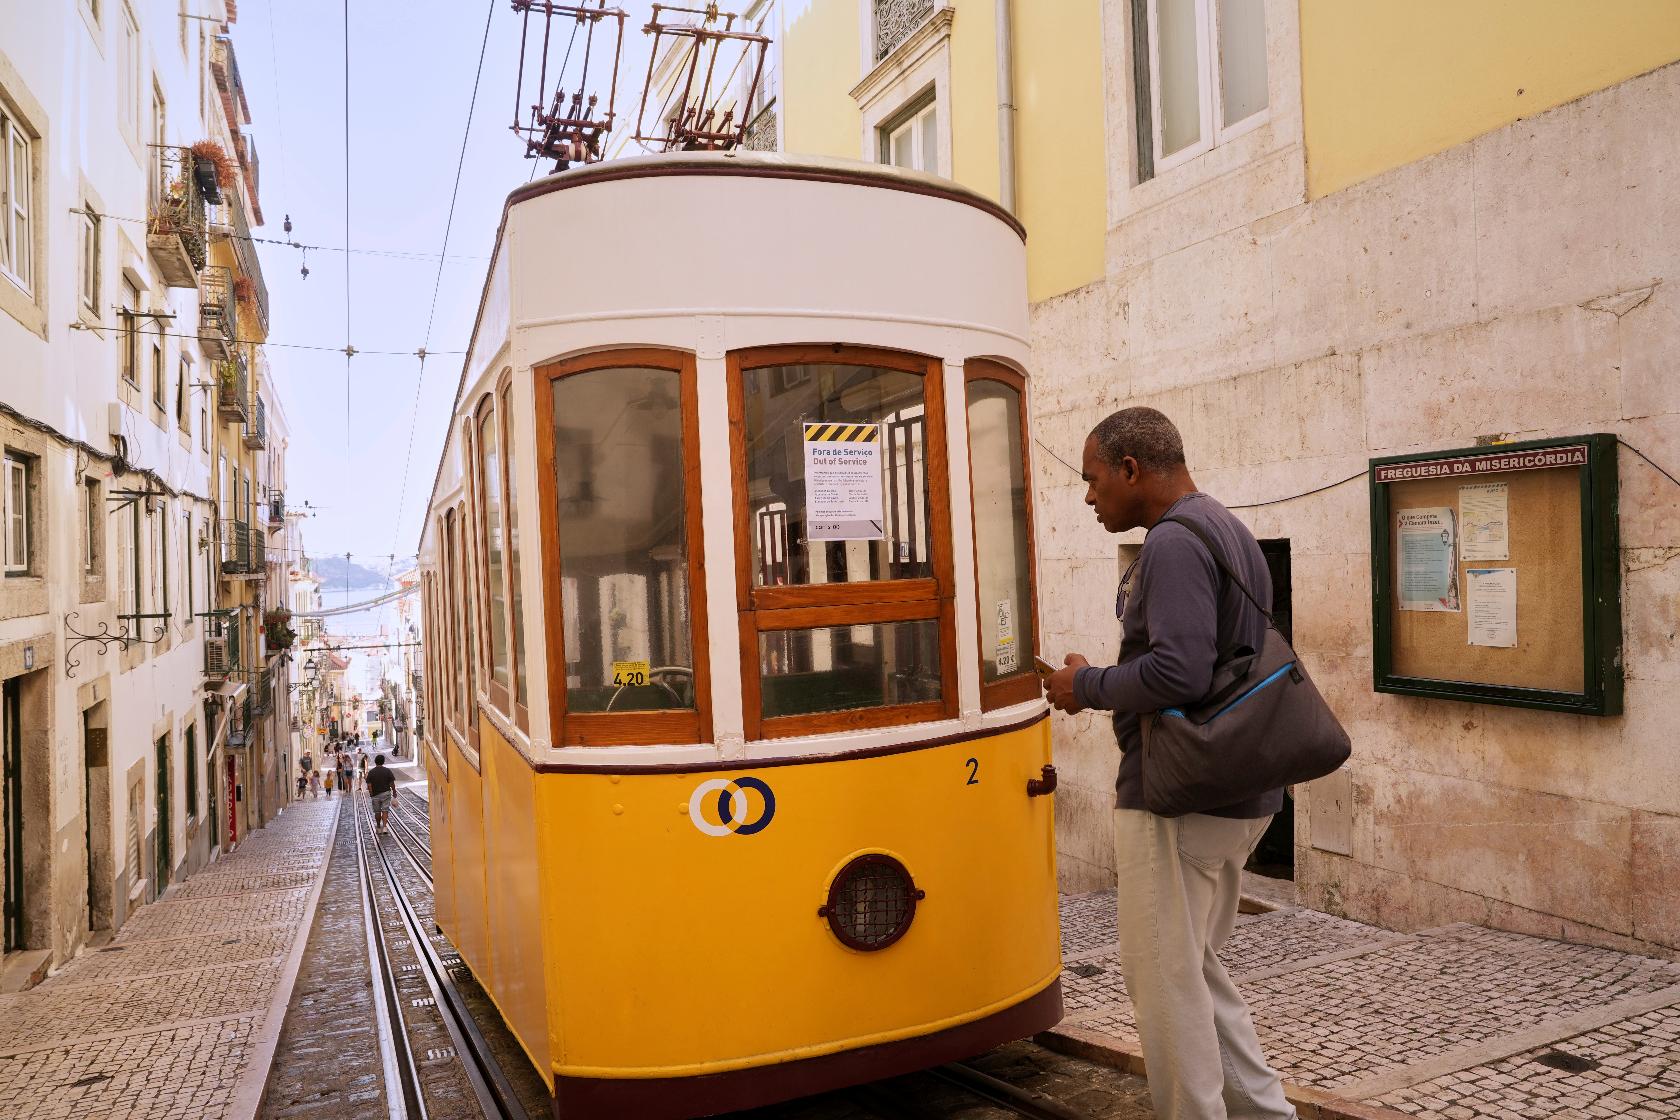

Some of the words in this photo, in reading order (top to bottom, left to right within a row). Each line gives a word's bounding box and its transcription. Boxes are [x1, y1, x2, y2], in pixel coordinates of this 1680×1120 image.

[838, 457, 867, 465] Service
[844, 449, 872, 457] Serviço
[1380, 464, 1450, 480] FREGUESIA
[1453, 463, 1472, 474] DA
[1475, 451, 1584, 471] MISERICÓRDIA
[613, 671, 644, 687] 4.20
[965, 757, 979, 785] 2
